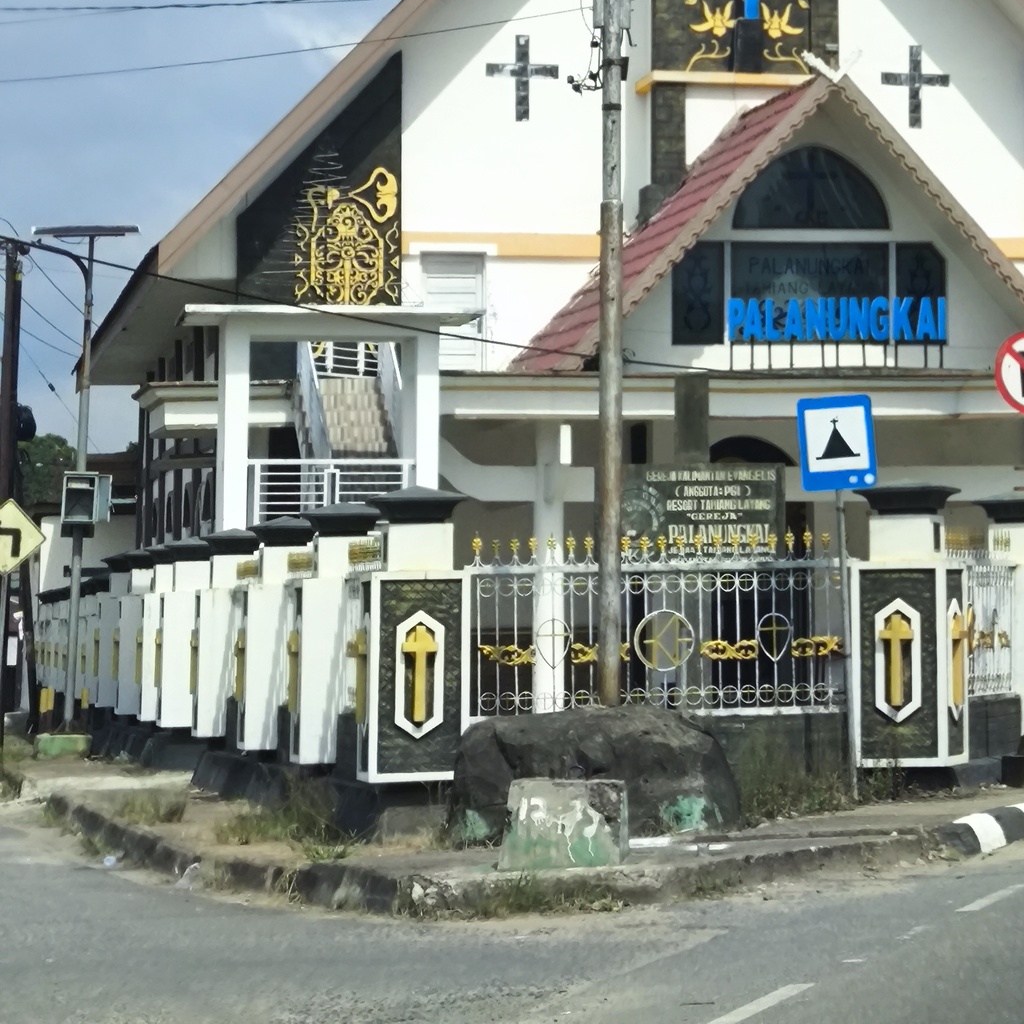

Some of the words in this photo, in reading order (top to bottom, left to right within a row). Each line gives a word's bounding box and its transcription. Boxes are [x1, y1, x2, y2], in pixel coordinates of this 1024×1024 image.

[748, 257, 870, 275] PALANUNGKAI
[727, 296, 946, 341] PALANUNGKAI
[728, 469, 777, 482] EVANGELIS
[666, 499, 697, 511] RESORT
[738, 498, 771, 510] LAYANG
[668, 523, 770, 544] PALANUNGKAI
